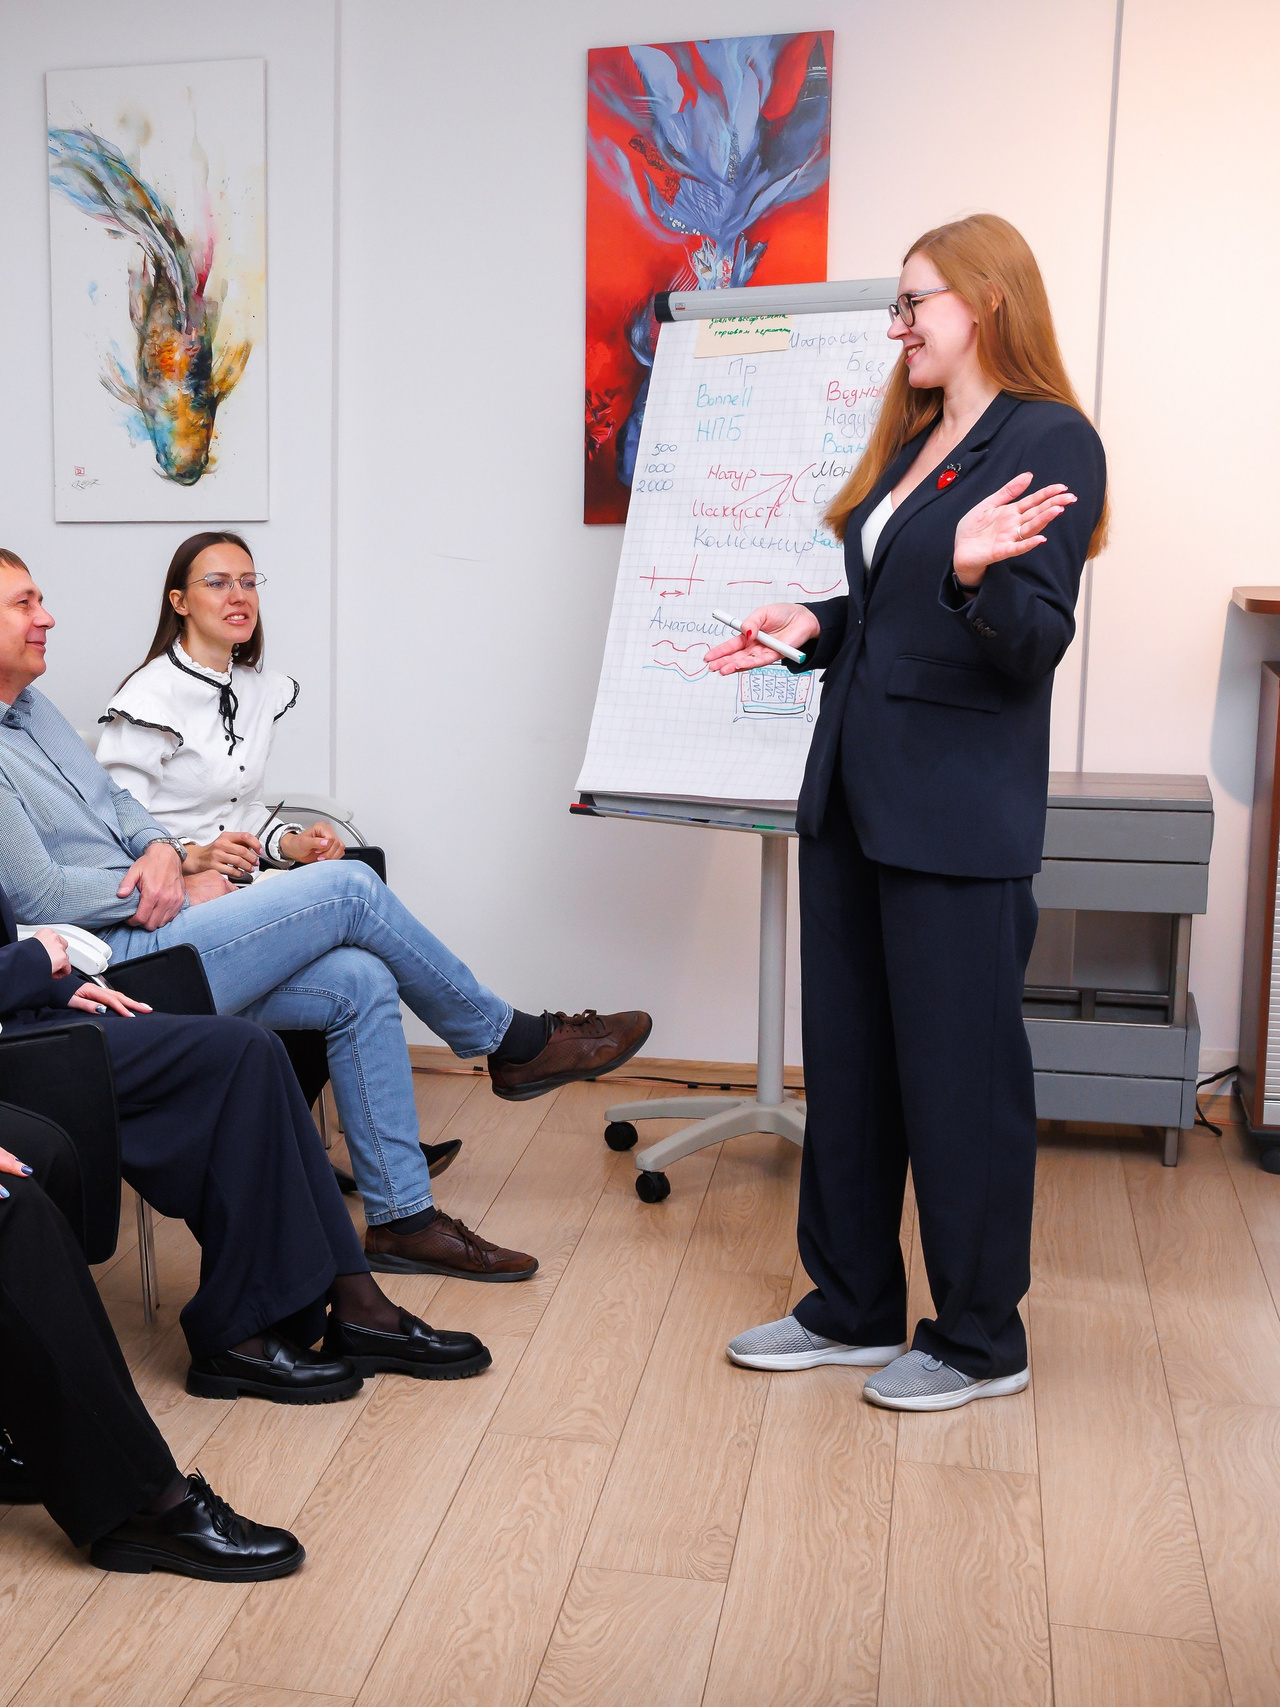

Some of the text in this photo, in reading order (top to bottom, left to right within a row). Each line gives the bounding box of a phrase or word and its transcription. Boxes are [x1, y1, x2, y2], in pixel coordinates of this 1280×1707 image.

[789, 332, 868, 354] Матрасы
[728, 357, 757, 387] Пр
[846, 350, 885, 383] Без
[696, 383, 753, 407] Bonnell
[696, 414, 746, 442] НПБ
[651, 443, 677, 456] 500
[644, 462, 676, 474] 1000
[707, 464, 757, 491] Натур
[636, 478, 674, 493] 2000
